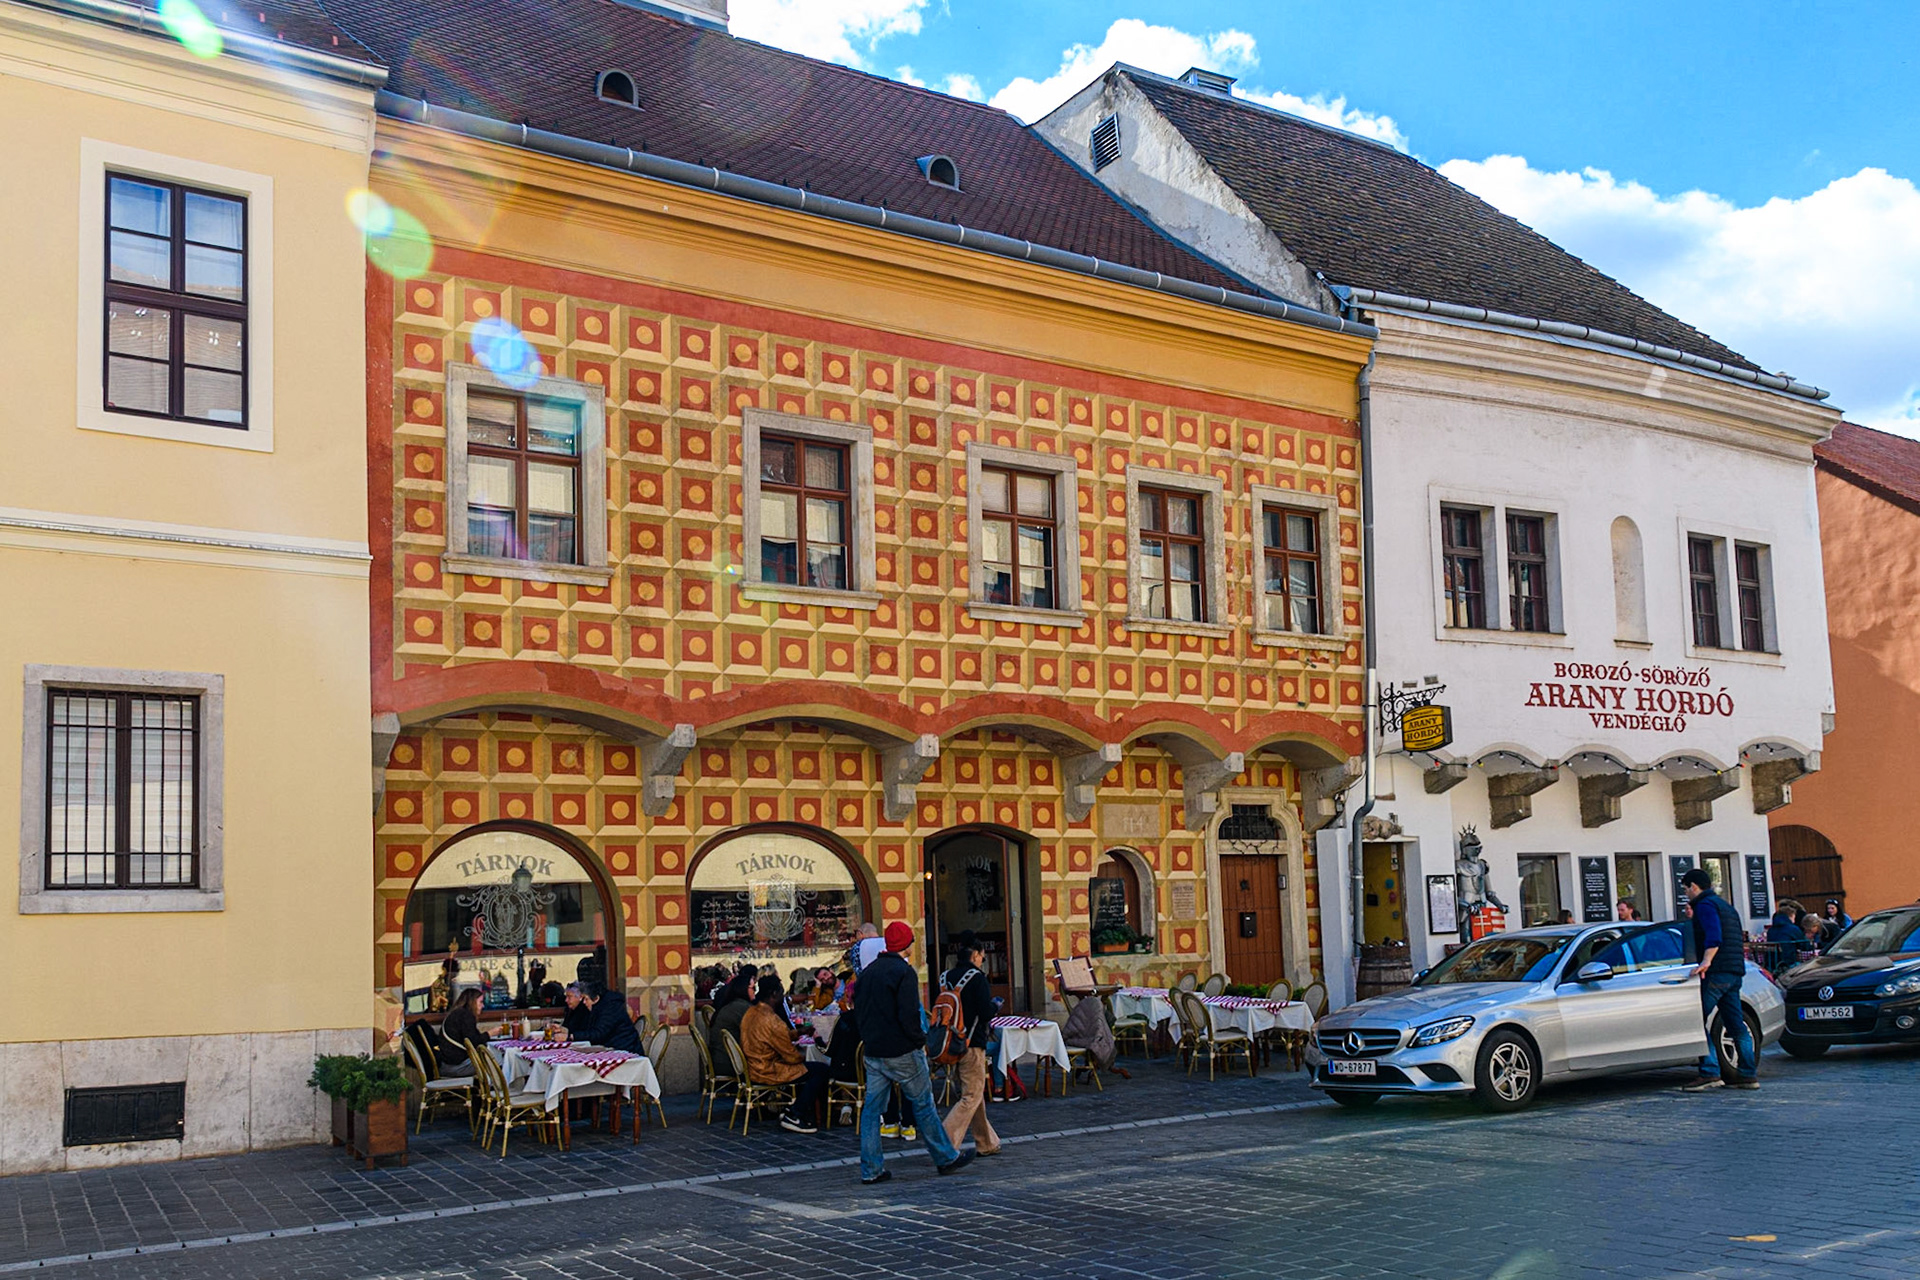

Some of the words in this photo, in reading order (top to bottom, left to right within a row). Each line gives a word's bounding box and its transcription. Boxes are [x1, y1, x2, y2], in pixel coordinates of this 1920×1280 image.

[1524, 683, 1627, 710] ARANY
[1634, 687, 1735, 717] HORDÓ
[1408, 717, 1437, 729] ARANY
[1589, 712, 1687, 732] VENDÉGLŐ
[456, 853, 555, 877] TÁRNOK
[736, 853, 817, 875] TÁRNOK
[788, 947, 818, 958] BIER
[502, 958, 515, 970] &
[1806, 1007, 1850, 1018] LMY-562
